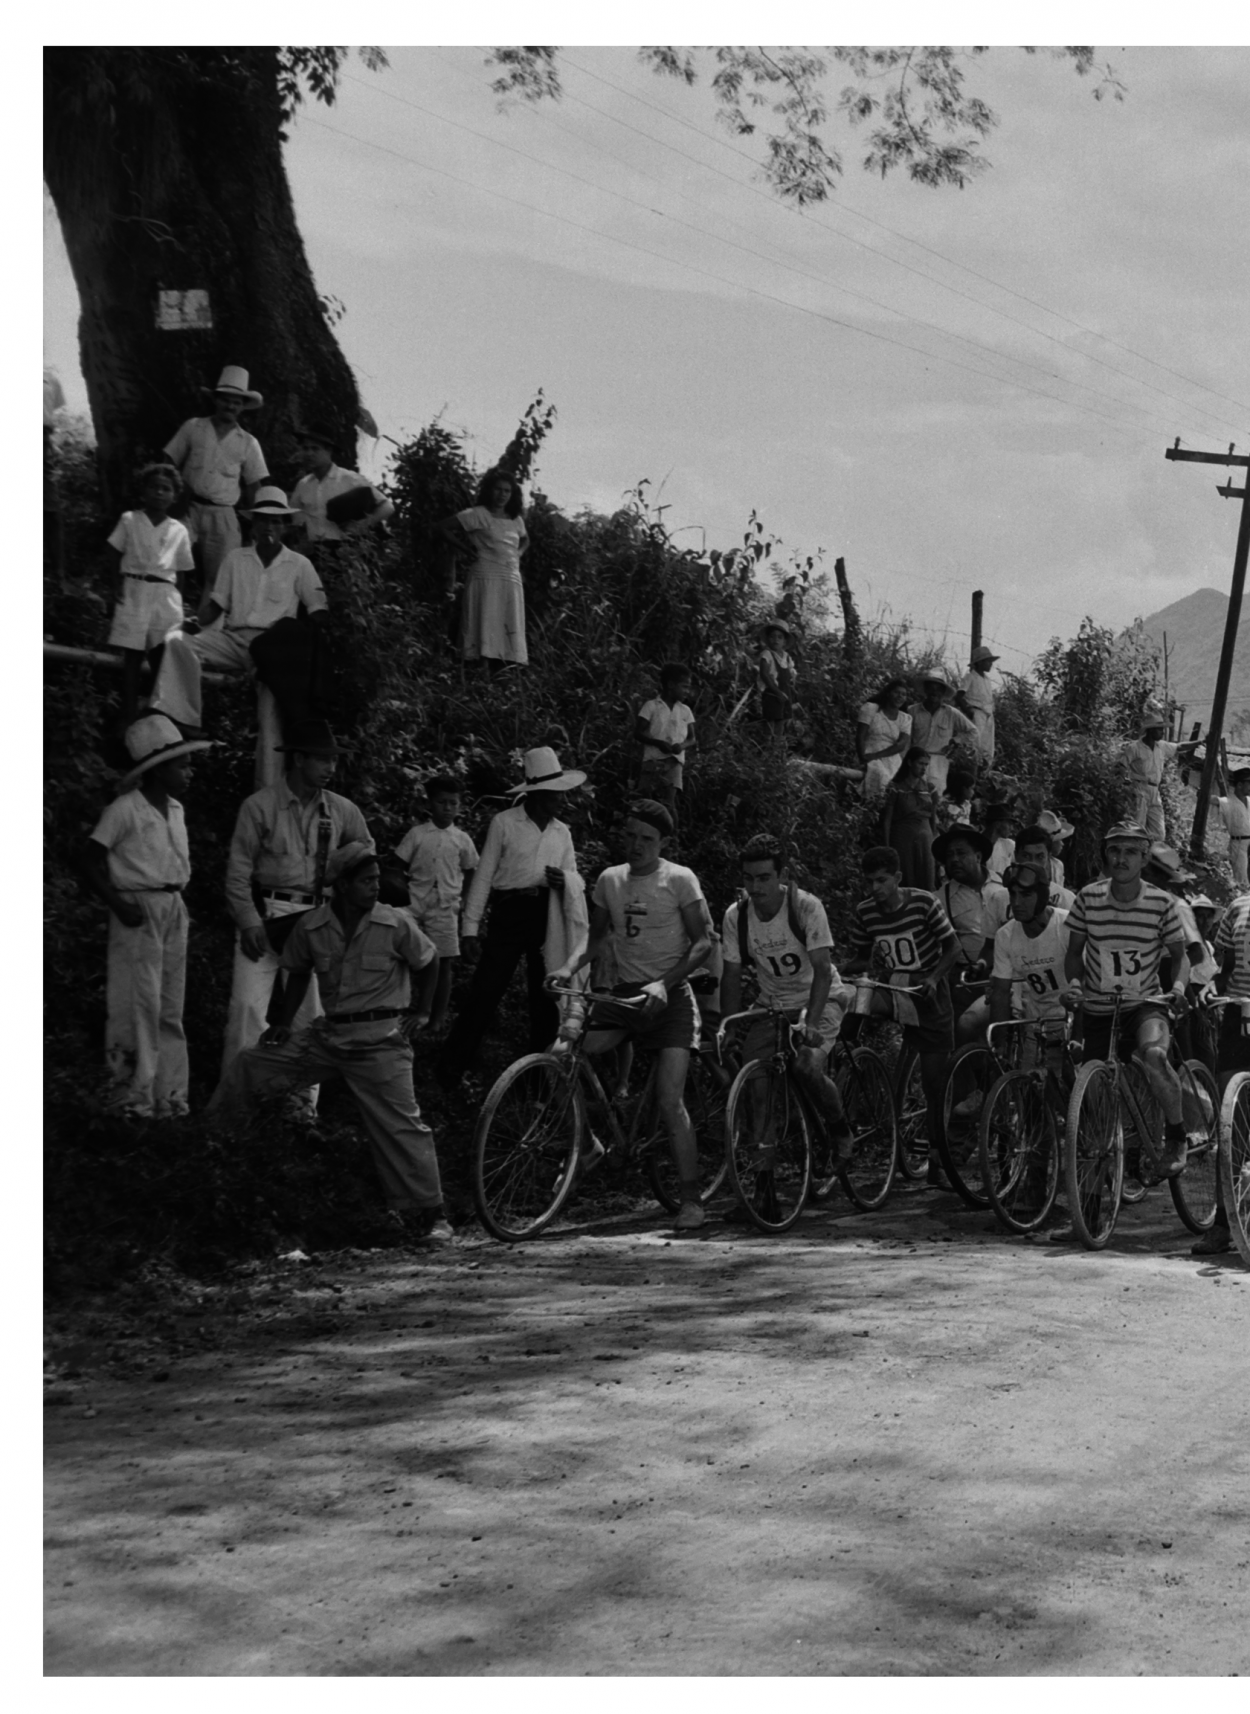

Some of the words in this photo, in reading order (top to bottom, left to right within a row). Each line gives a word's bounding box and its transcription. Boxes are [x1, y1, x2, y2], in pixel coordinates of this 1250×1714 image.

[766, 952, 802, 977] 19
[1110, 950, 1141, 977] 13
[1027, 968, 1059, 995] 81
